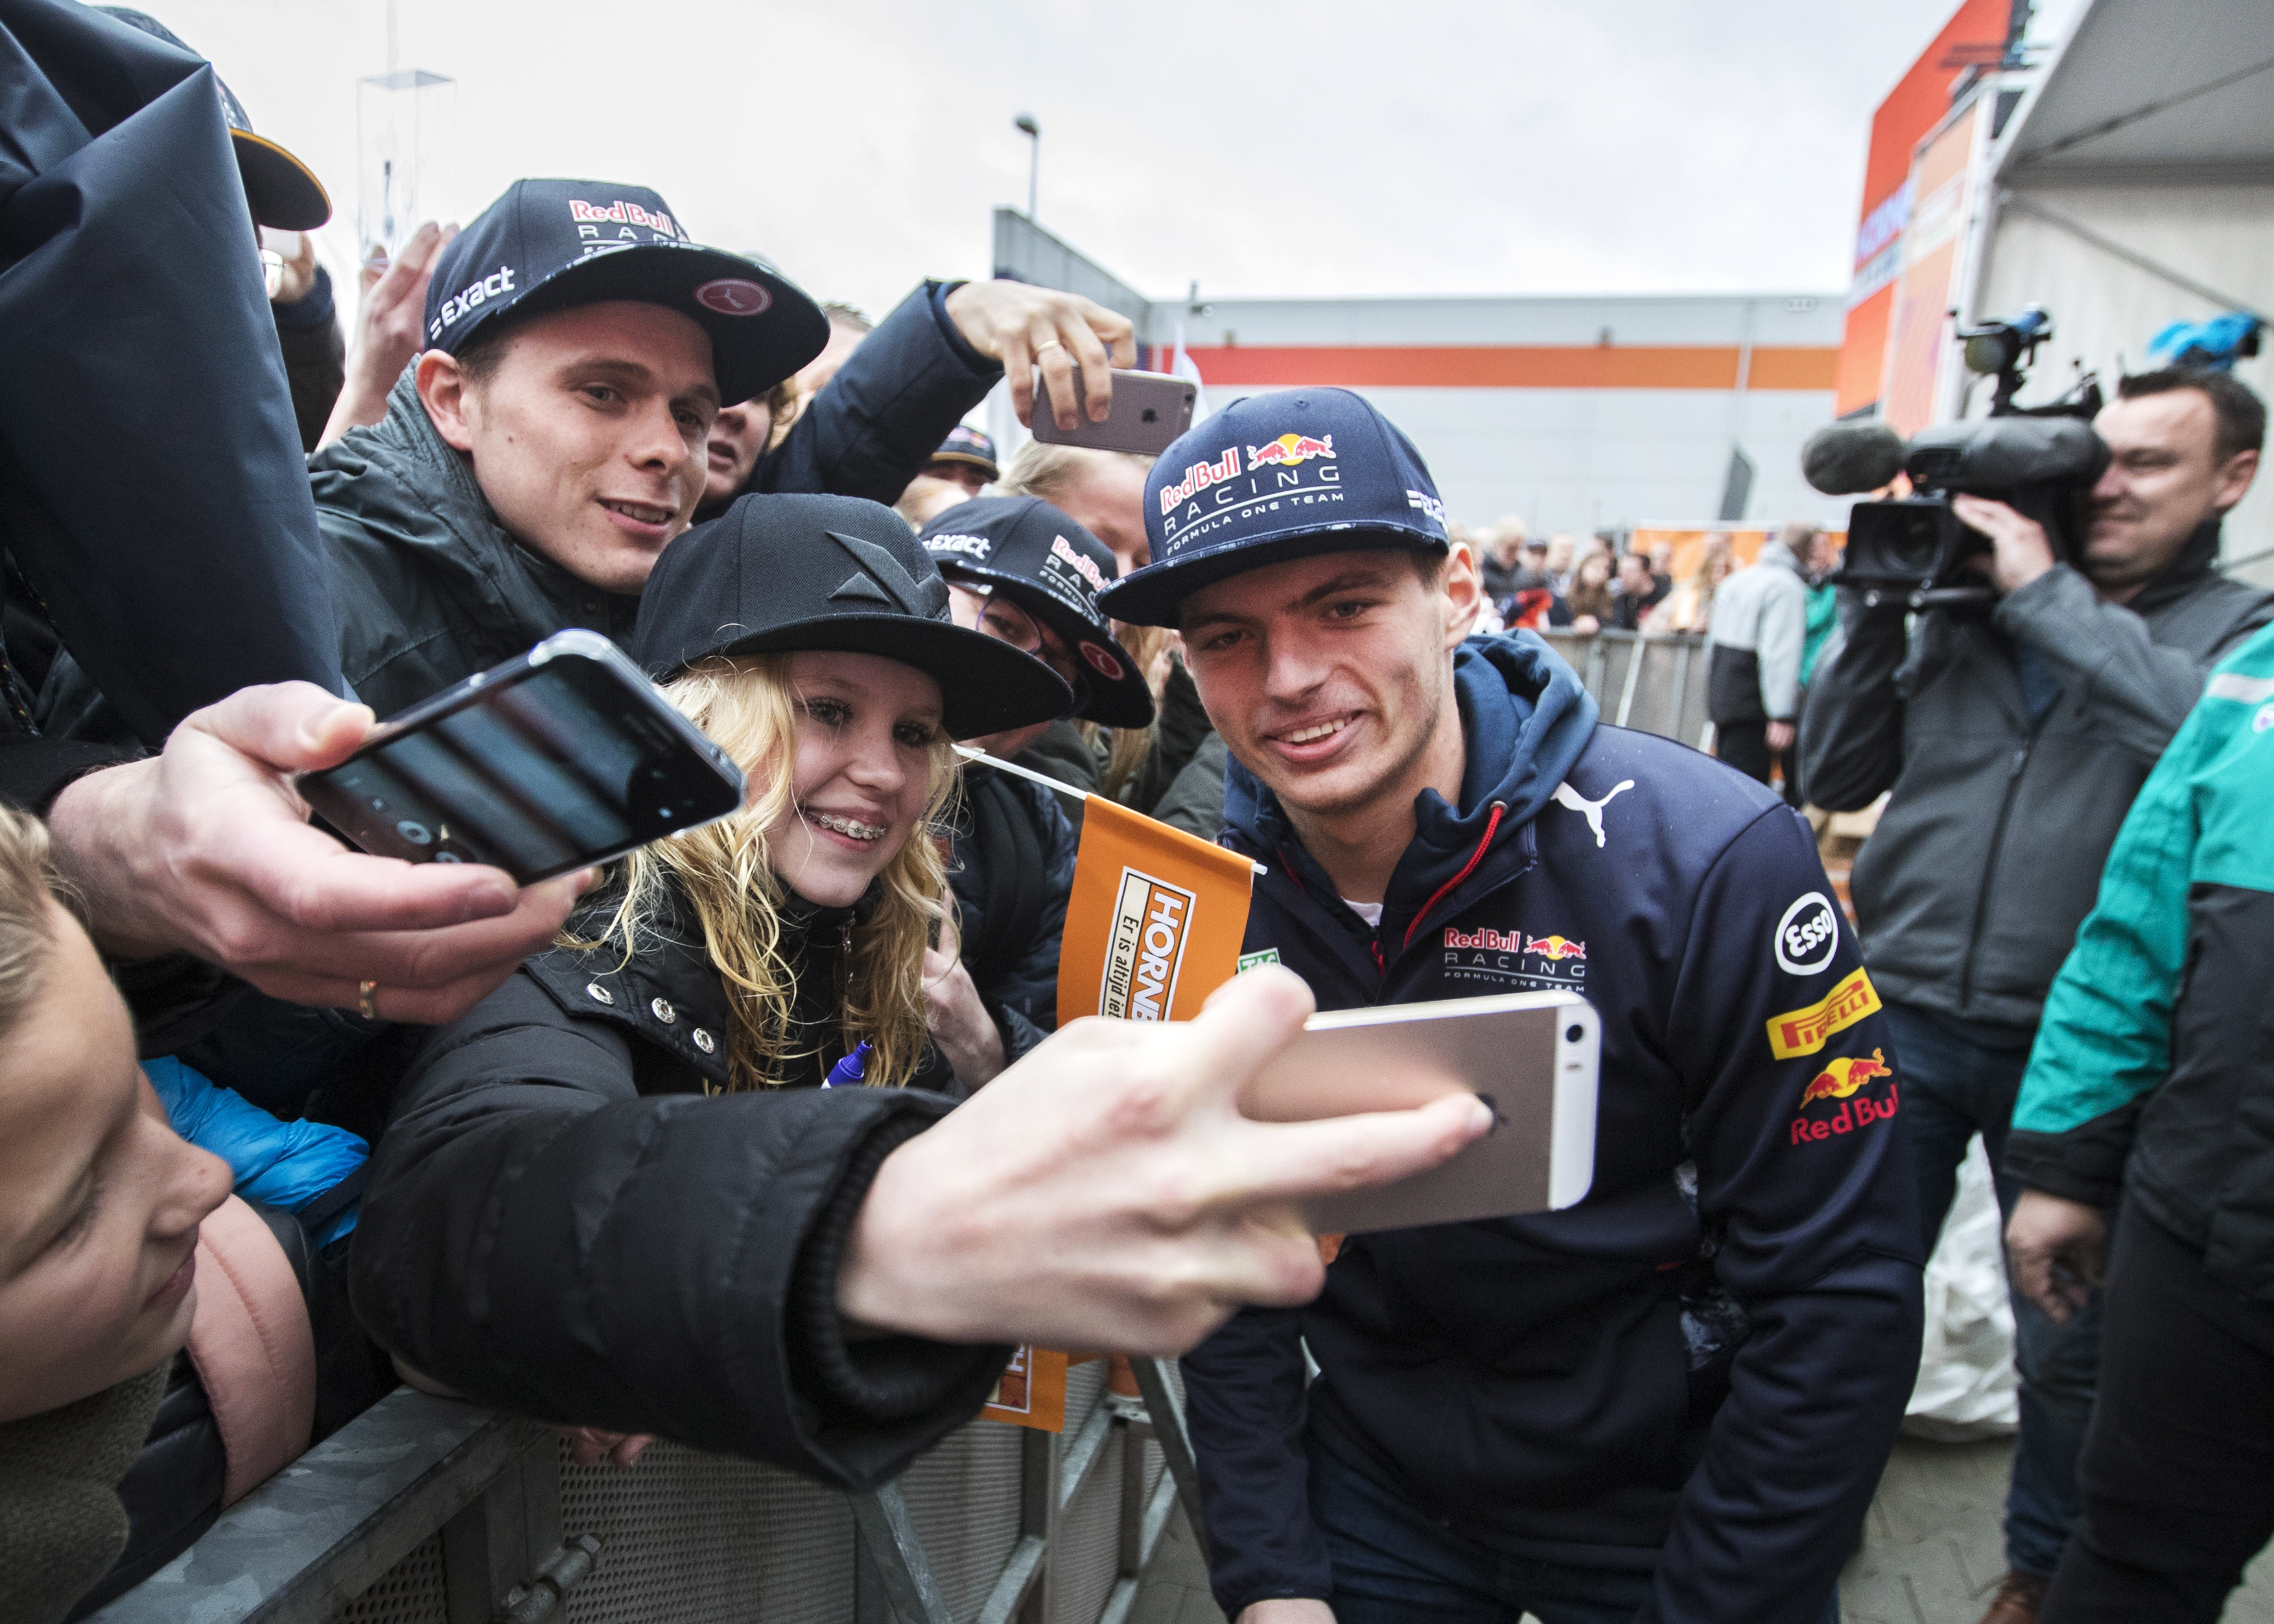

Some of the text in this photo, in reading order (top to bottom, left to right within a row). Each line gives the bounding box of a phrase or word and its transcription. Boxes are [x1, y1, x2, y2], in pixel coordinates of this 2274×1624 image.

[569, 200, 675, 238] Red Bull
[1160, 446, 1241, 516] Red Bull
[1164, 465, 1340, 536] RACING
[1051, 534, 1090, 575] Red
[1167, 493, 1344, 556] FORMULA ONE TEAM
[1131, 892, 1183, 1022] HORNB
[1444, 927, 1520, 953] Red Bull
[1444, 952, 1585, 977] RACING
[1785, 909, 1833, 957] Esso
[1108, 915, 1140, 1019] Er is altijd iet
[1444, 973, 1584, 992] FORMULA ONE TEAM
[1781, 979, 1870, 1049] PIRELLI
[1790, 1082, 1899, 1145] Red Bul
